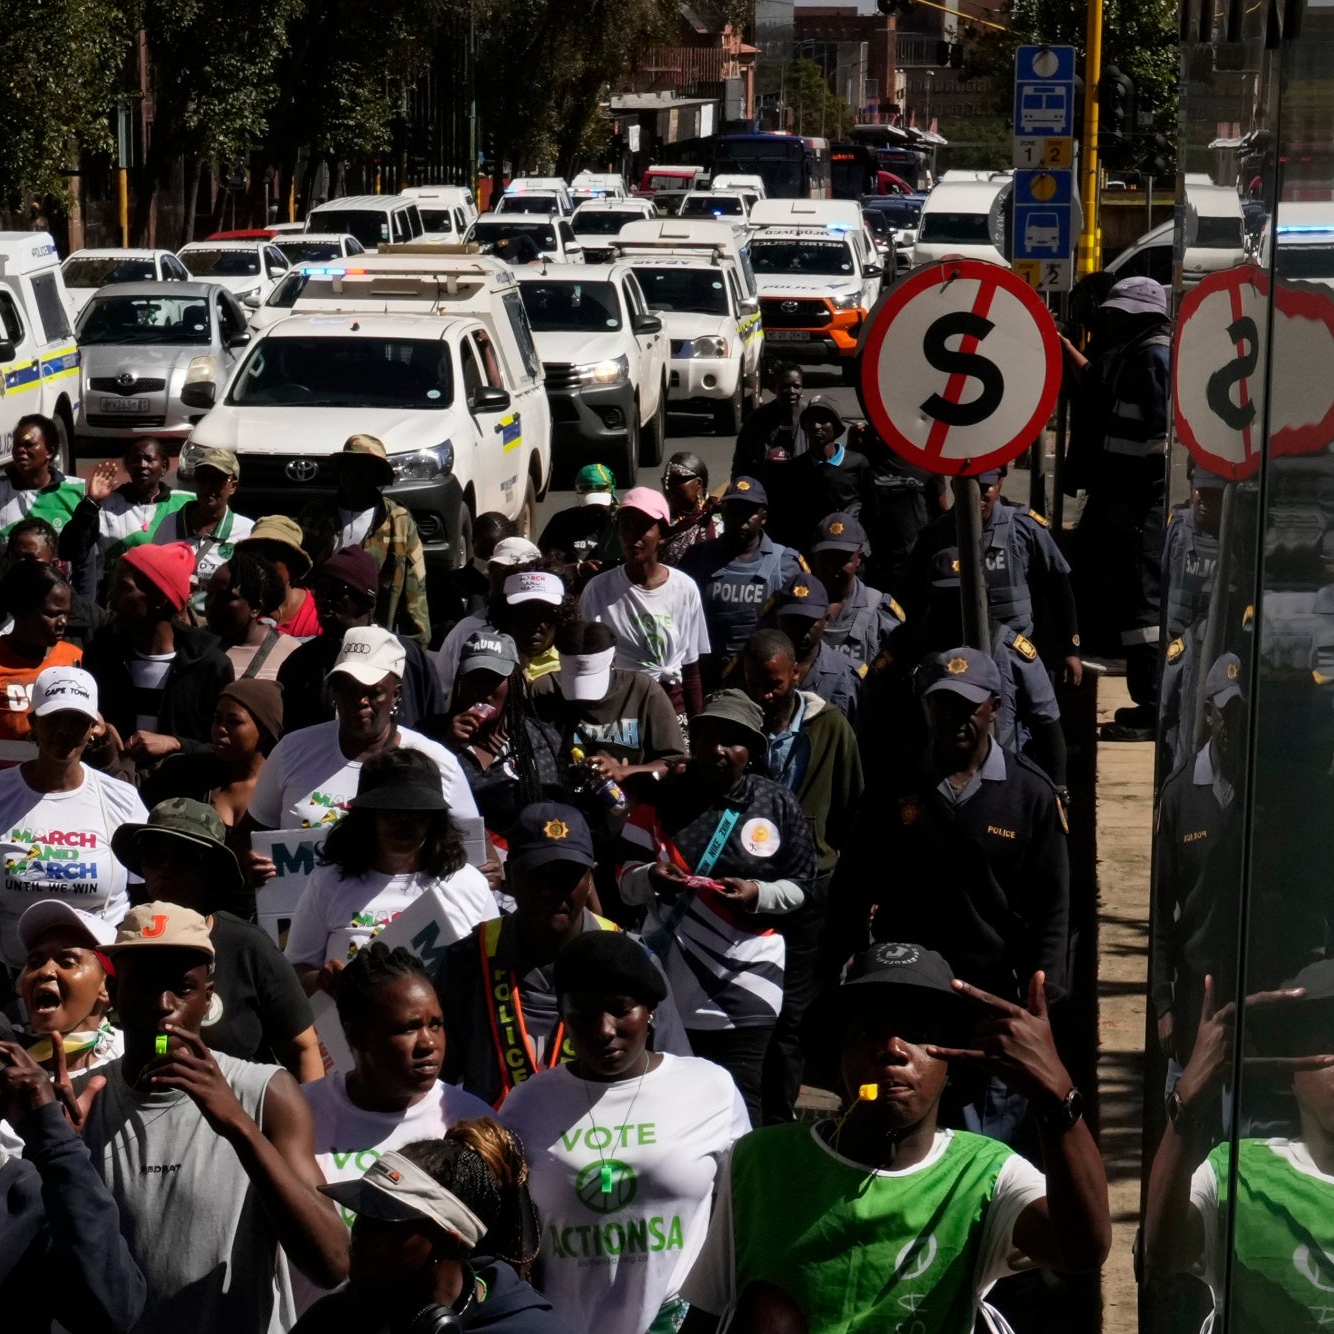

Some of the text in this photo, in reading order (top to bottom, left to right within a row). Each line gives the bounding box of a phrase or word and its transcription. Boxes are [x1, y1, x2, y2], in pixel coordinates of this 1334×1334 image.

[1024, 147, 1032, 163] 1
[1050, 147, 1061, 163] 2
[1024, 271, 1031, 285] 1
[1049, 269, 1059, 285] 2
[919, 311, 1004, 427] S
[712, 582, 765, 604] POLICE
[69, 686, 90, 701] TOWN
[10, 827, 97, 849] MARCH
[986, 825, 1017, 839] POLICE
[26, 844, 80, 863] AND
[4, 859, 98, 881] MARCH
[4, 880, 98, 894] UNTIL WE WIN
[141, 914, 170, 938] J
[560, 1123, 657, 1152] VOTE
[549, 1216, 684, 1259] ACTIONSA
